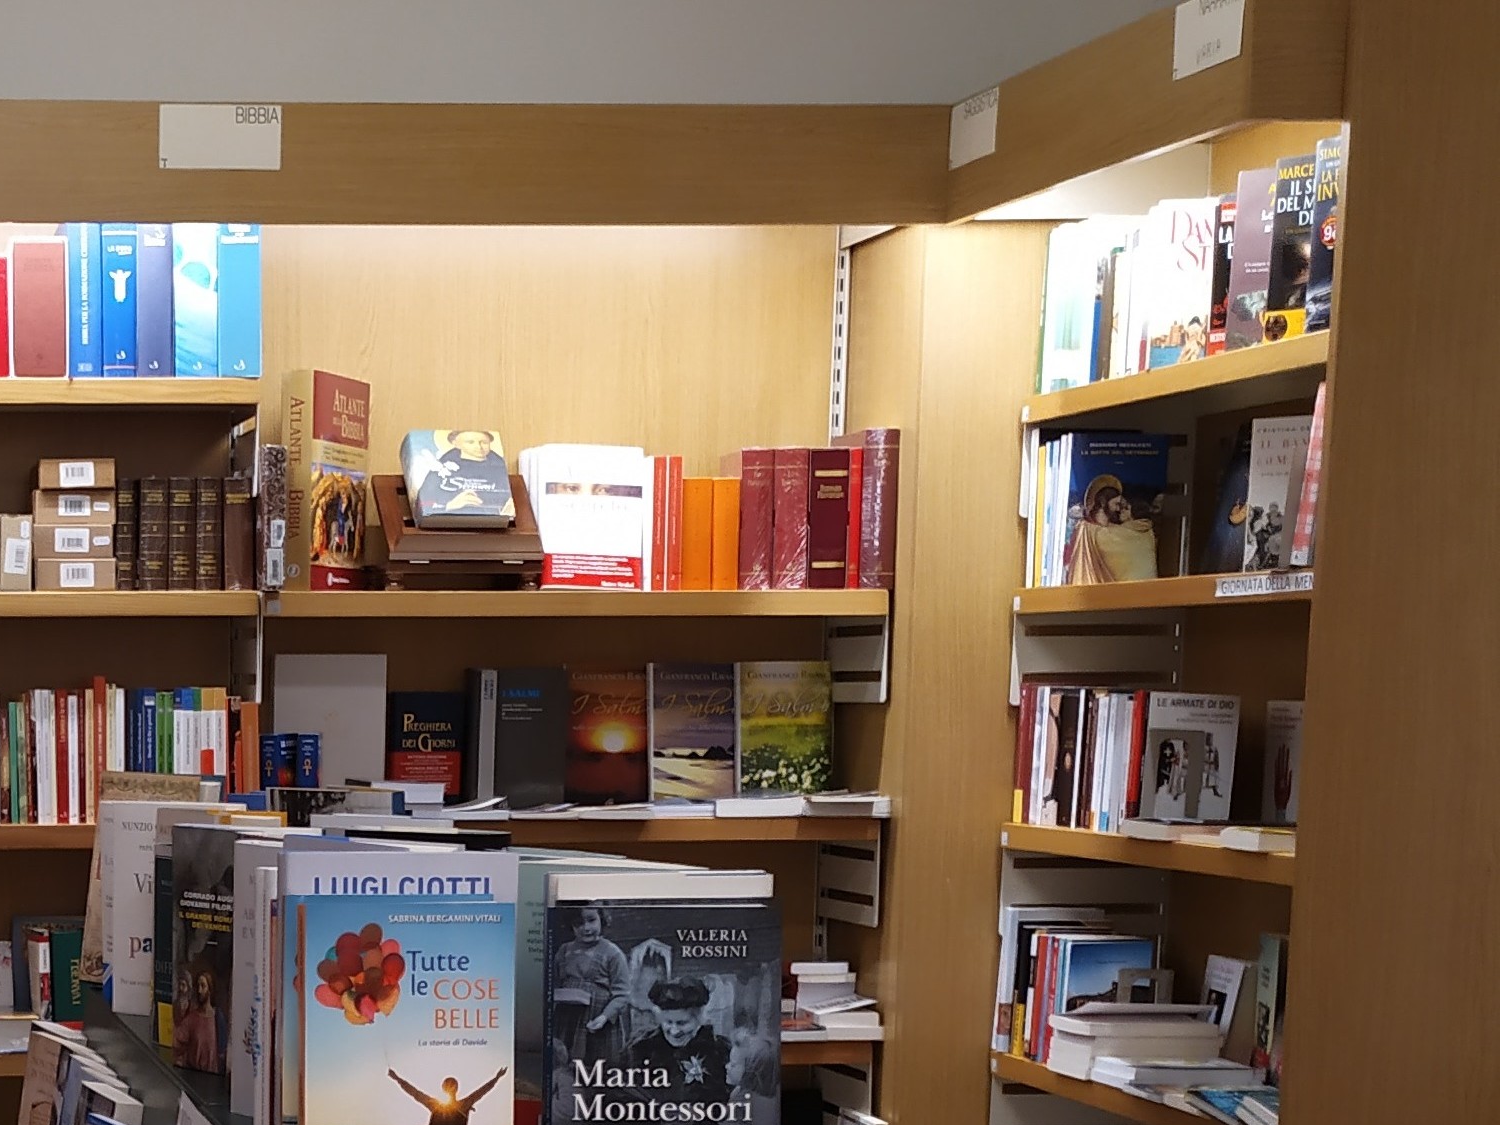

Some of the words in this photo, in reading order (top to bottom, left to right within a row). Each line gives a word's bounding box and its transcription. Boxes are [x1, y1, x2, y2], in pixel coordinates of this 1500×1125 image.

[235, 106, 280, 125] BIBBIA
[333, 389, 366, 418] ATLANTE
[289, 396, 306, 466] ATLANTE
[288, 489, 304, 540] BIBBIA
[402, 712, 453, 733] PREGHIERA
[122, 822, 153, 832] NUNZIO
[388, 914, 425, 924] SABRINA
[426, 914, 474, 923] BERGAMINI
[676, 929, 748, 942] VALERIA
[406, 950, 470, 972] Tutte
[681, 945, 748, 958] ROSSINI
[411, 974, 429, 996] le
[433, 978, 500, 1001] COSE
[434, 1008, 500, 1029] BELLE
[418, 1039, 428, 1047] La
[452, 1038, 460, 1047] di
[462, 1038, 488, 1047] Davide
[572, 1058, 671, 1088] Maria
[571, 1092, 753, 1122] Montessori
